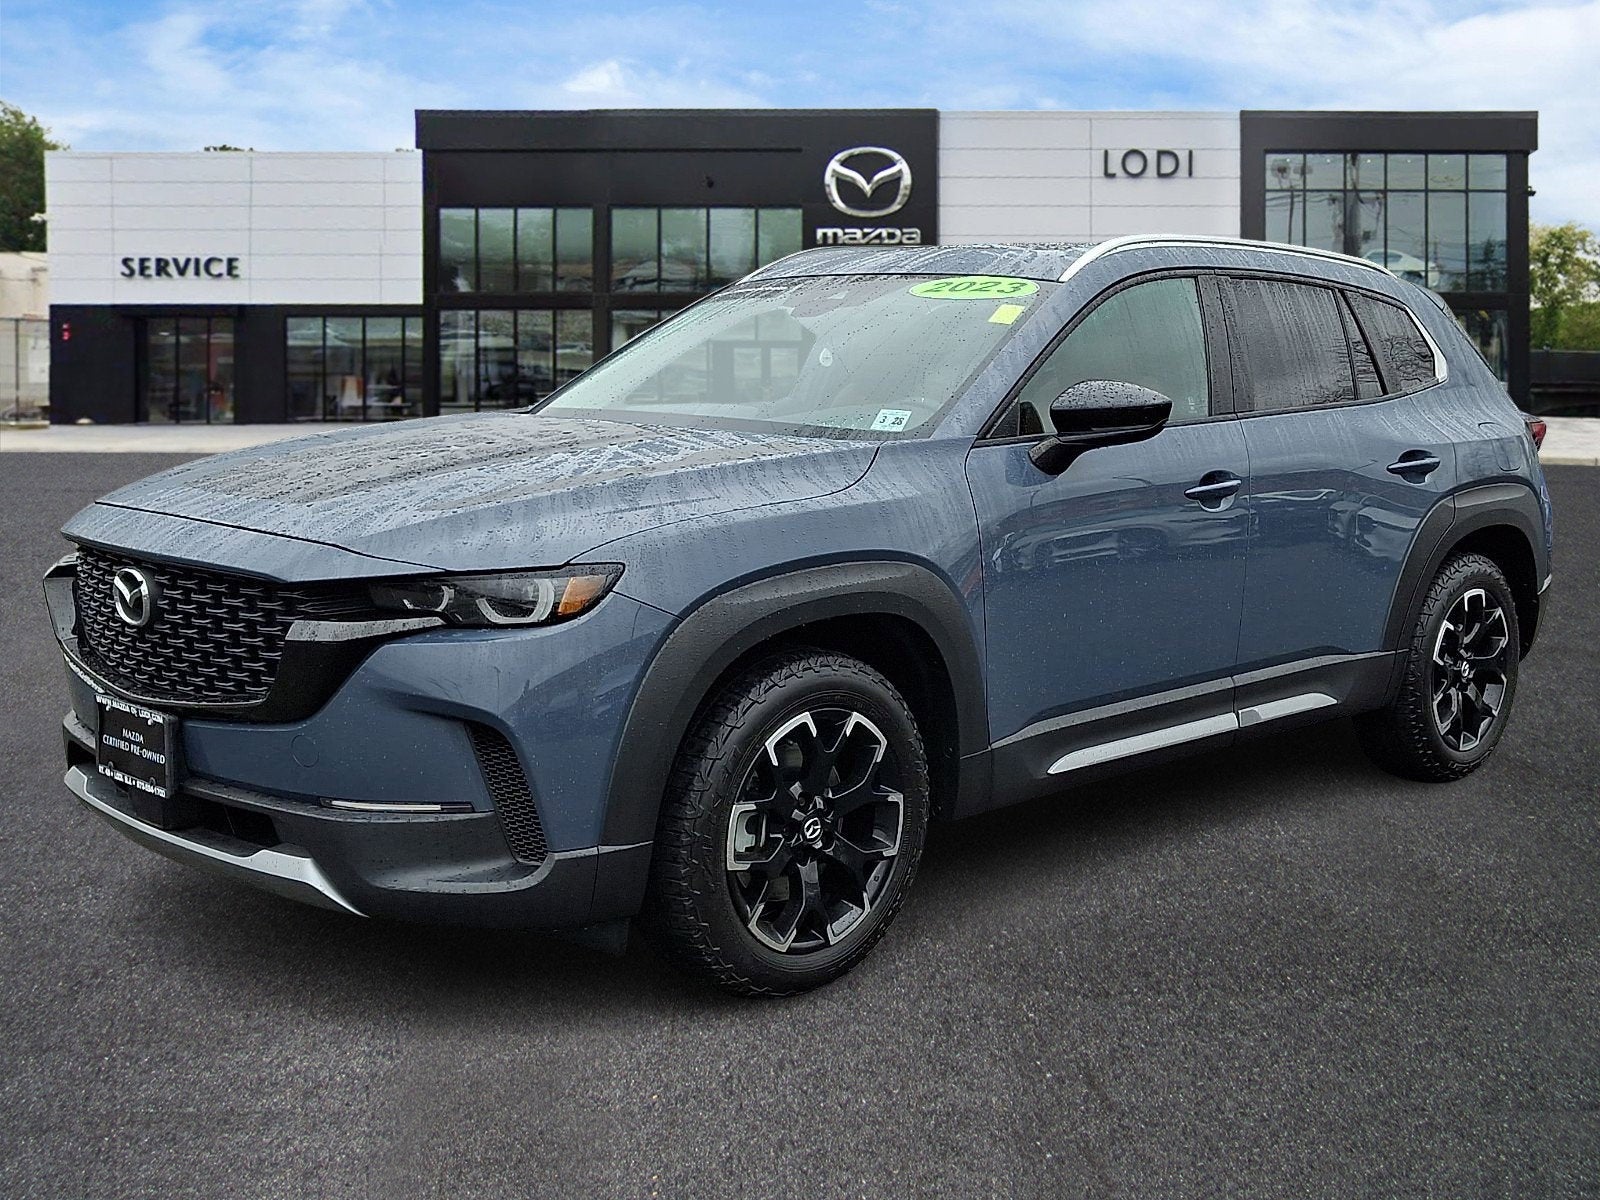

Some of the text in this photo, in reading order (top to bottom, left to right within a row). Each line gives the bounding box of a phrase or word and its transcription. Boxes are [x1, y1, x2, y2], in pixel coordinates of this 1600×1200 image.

[1104, 149, 1193, 178] LODI
[816, 227, 921, 244] mazda
[120, 257, 240, 278] SERVICE
[920, 281, 1027, 293] 2023
[122, 728, 144, 744] MAZDA
[102, 734, 166, 764] CERTIFIED PRE-OWNED
